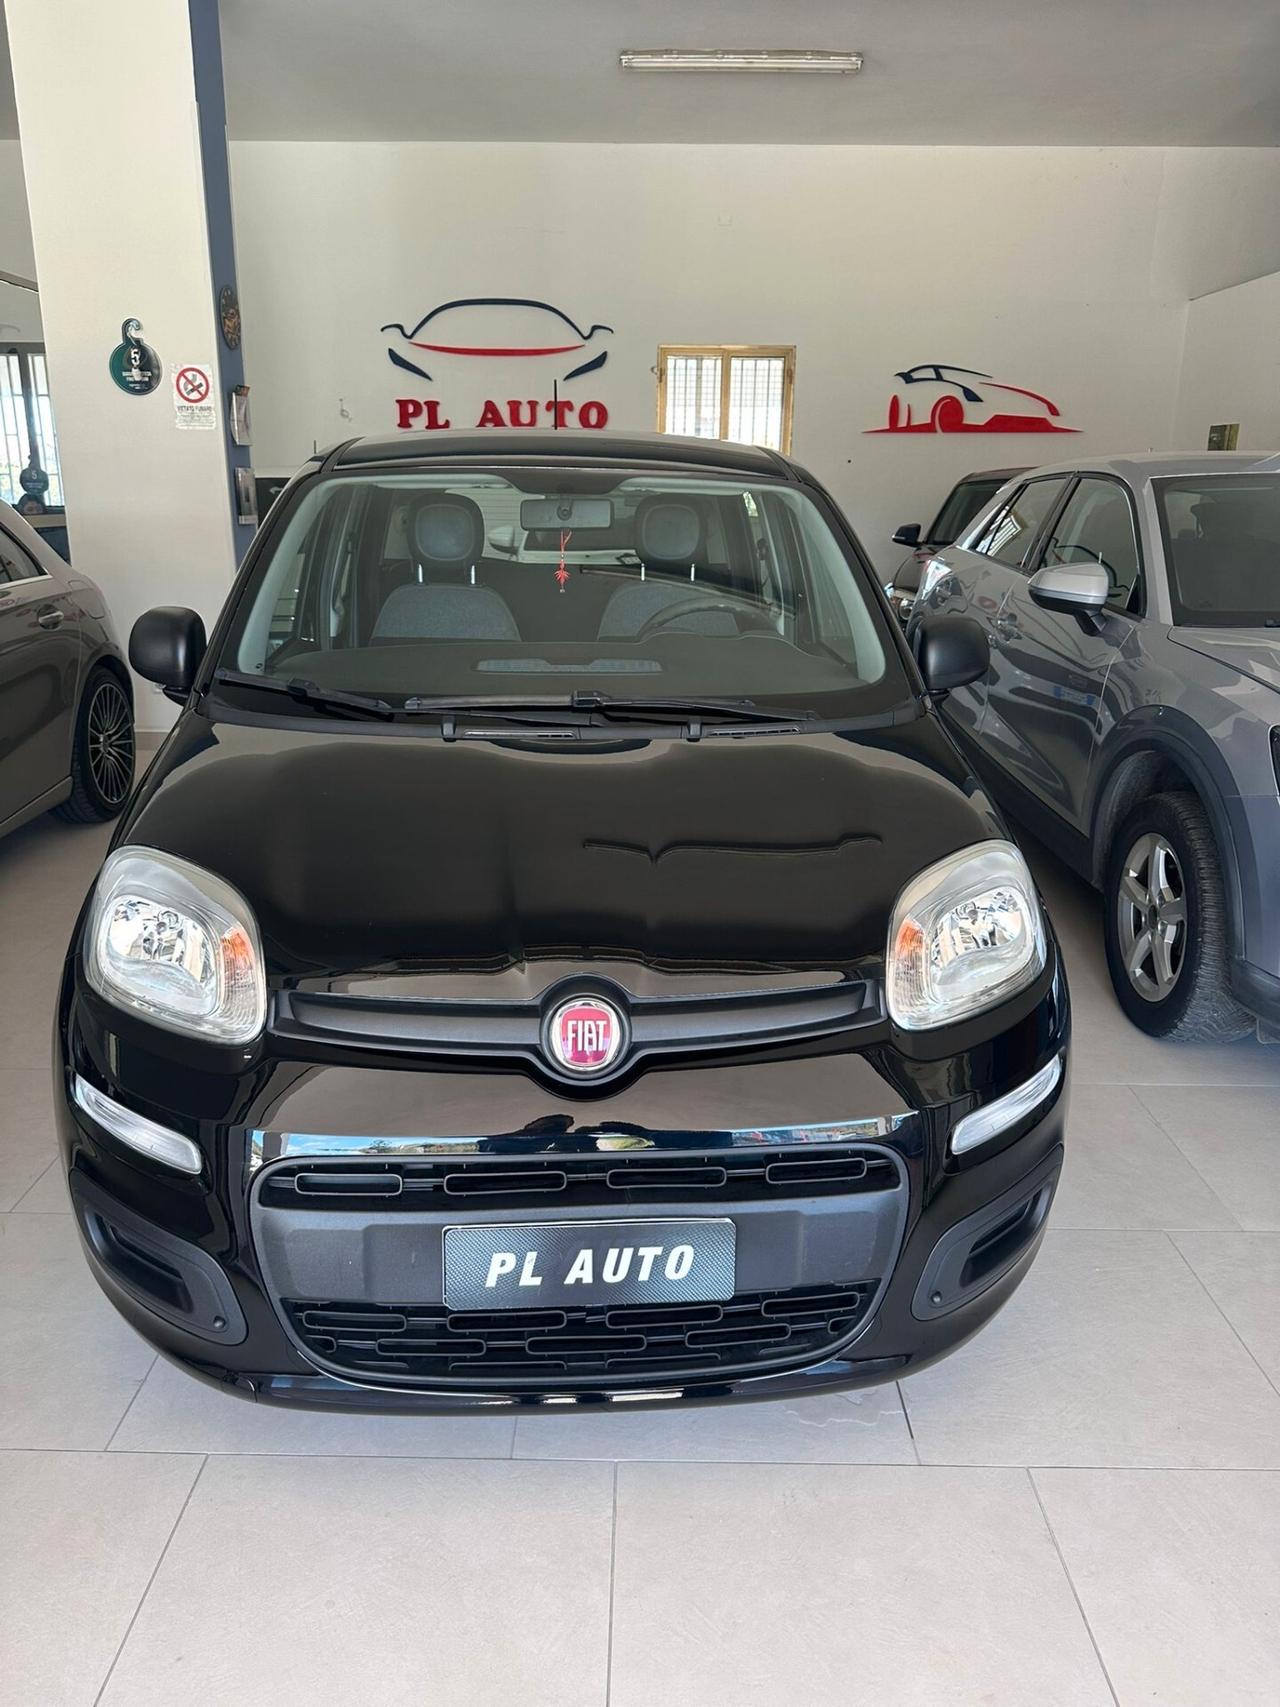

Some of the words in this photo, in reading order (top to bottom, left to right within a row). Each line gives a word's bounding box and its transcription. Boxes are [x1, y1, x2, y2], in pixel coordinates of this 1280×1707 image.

[131, 349, 140, 365] 5
[395, 399, 450, 429] PL
[475, 400, 609, 430] AUTO
[567, 1020, 608, 1052] FIAT
[485, 1252, 542, 1288] PL
[563, 1244, 695, 1285] AUTO
